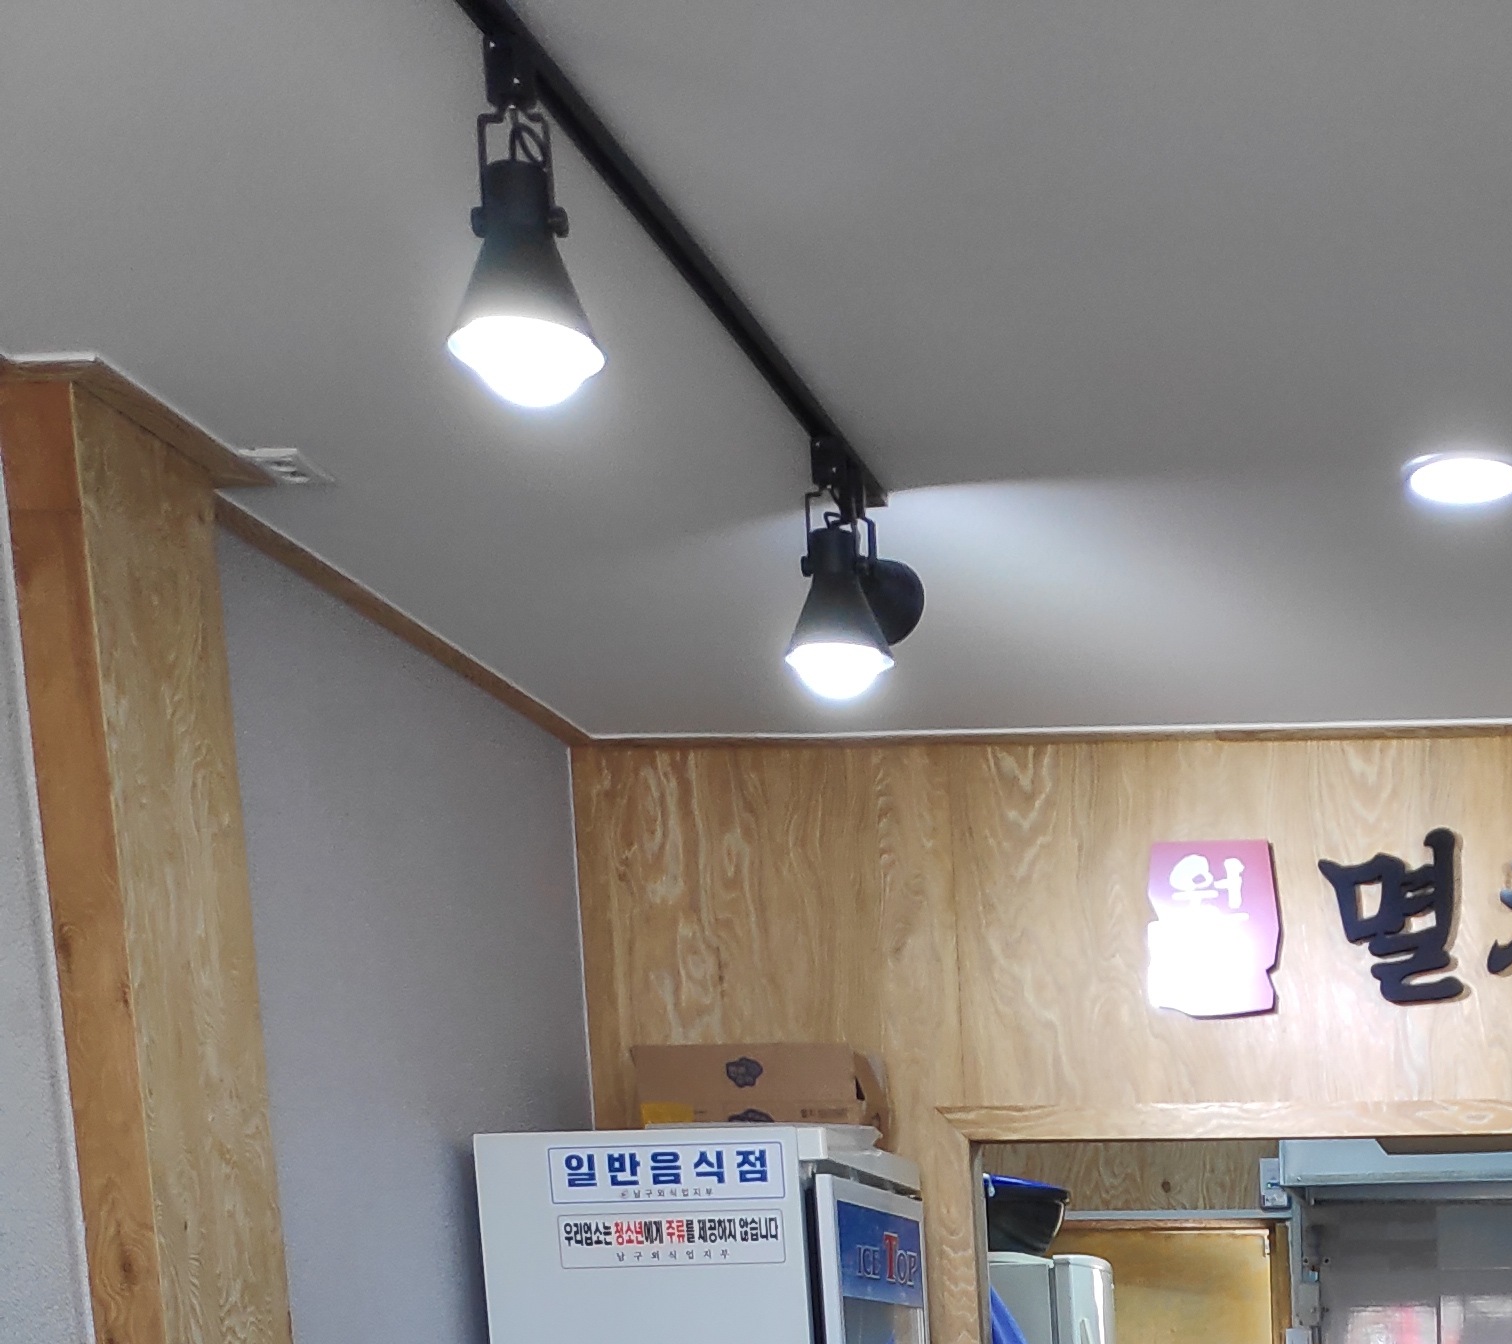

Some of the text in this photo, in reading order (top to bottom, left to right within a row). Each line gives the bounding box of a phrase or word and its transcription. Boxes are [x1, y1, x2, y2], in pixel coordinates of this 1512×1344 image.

[564, 1149, 769, 1188] 일반음식점
[563, 1216, 779, 1247] 우리업소는 청소년에게 주류를 제공하지 않습니다
[856, 1231, 918, 1287] ICE TOP
